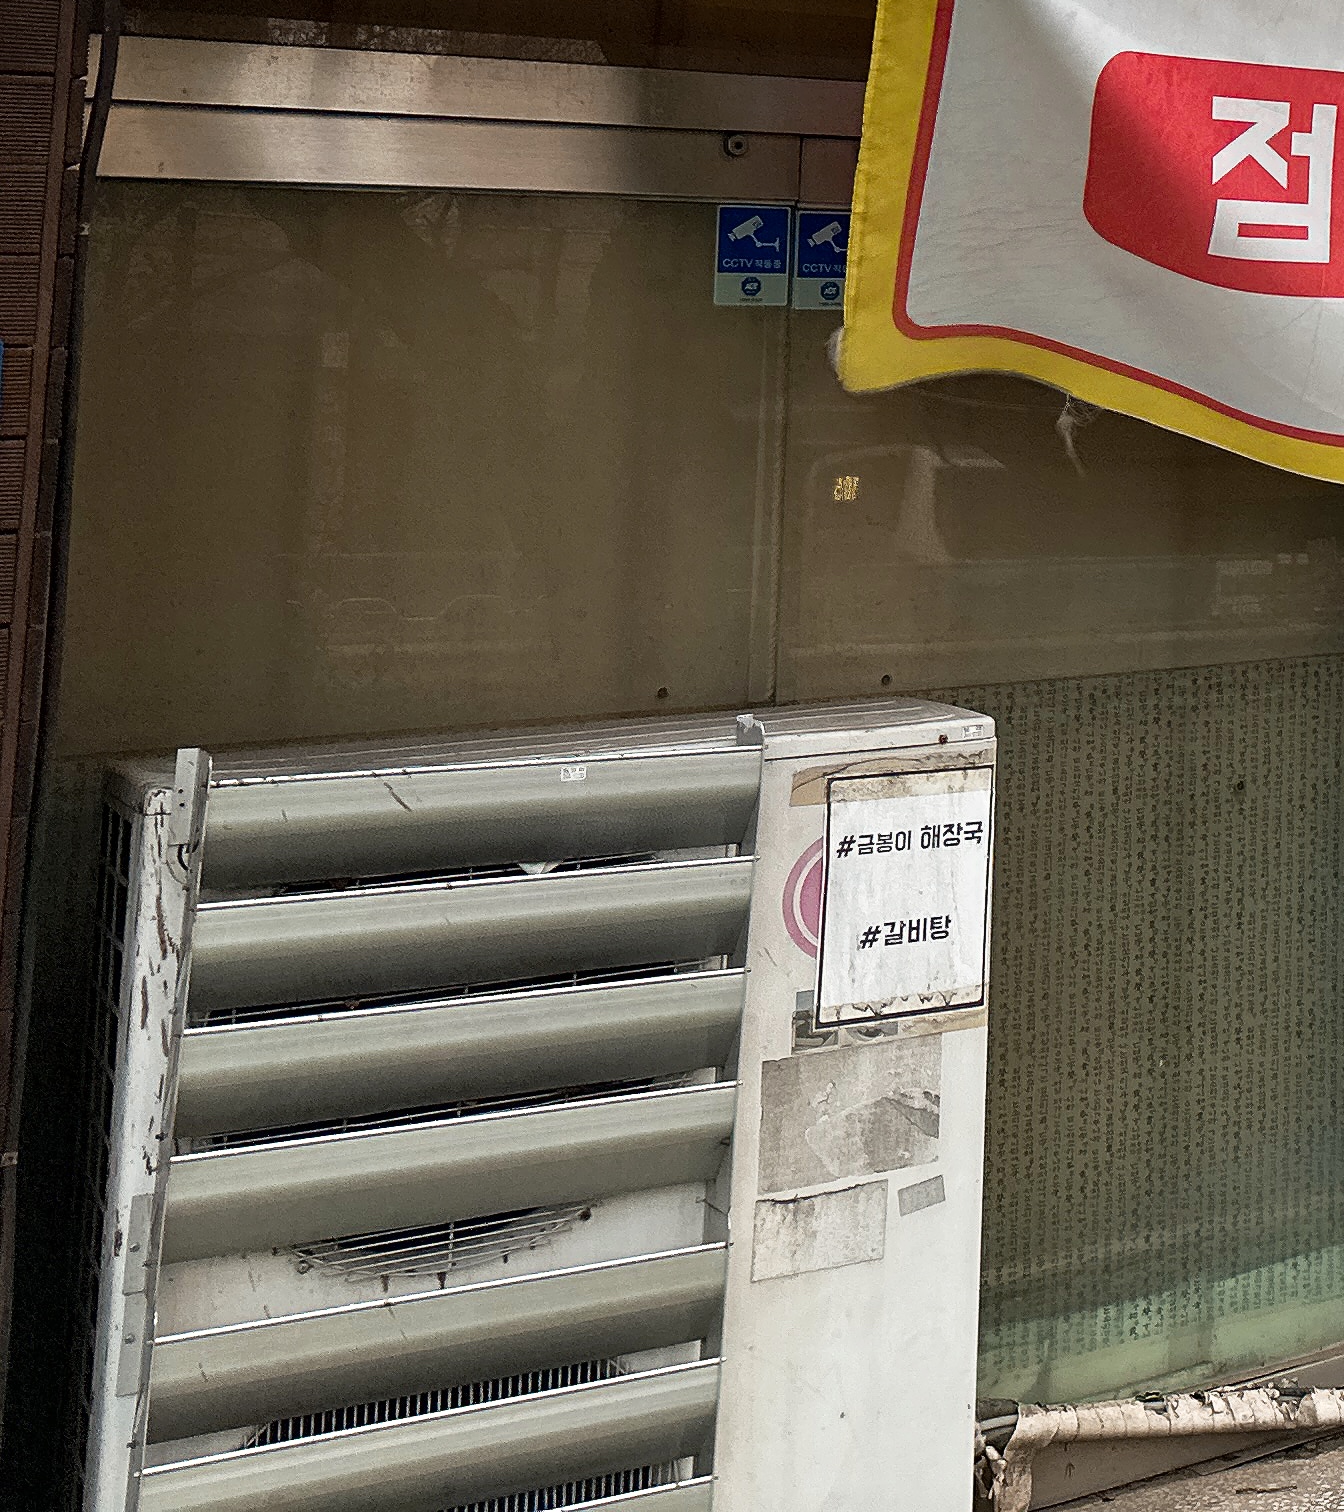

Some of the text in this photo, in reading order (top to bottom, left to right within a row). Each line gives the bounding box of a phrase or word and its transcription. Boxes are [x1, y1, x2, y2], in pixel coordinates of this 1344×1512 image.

[722, 258, 753, 268] CCTV
[802, 263, 832, 273] CCTV
[836, 820, 983, 858] #금봉이 해장국
[859, 915, 952, 950] #갈비탕
